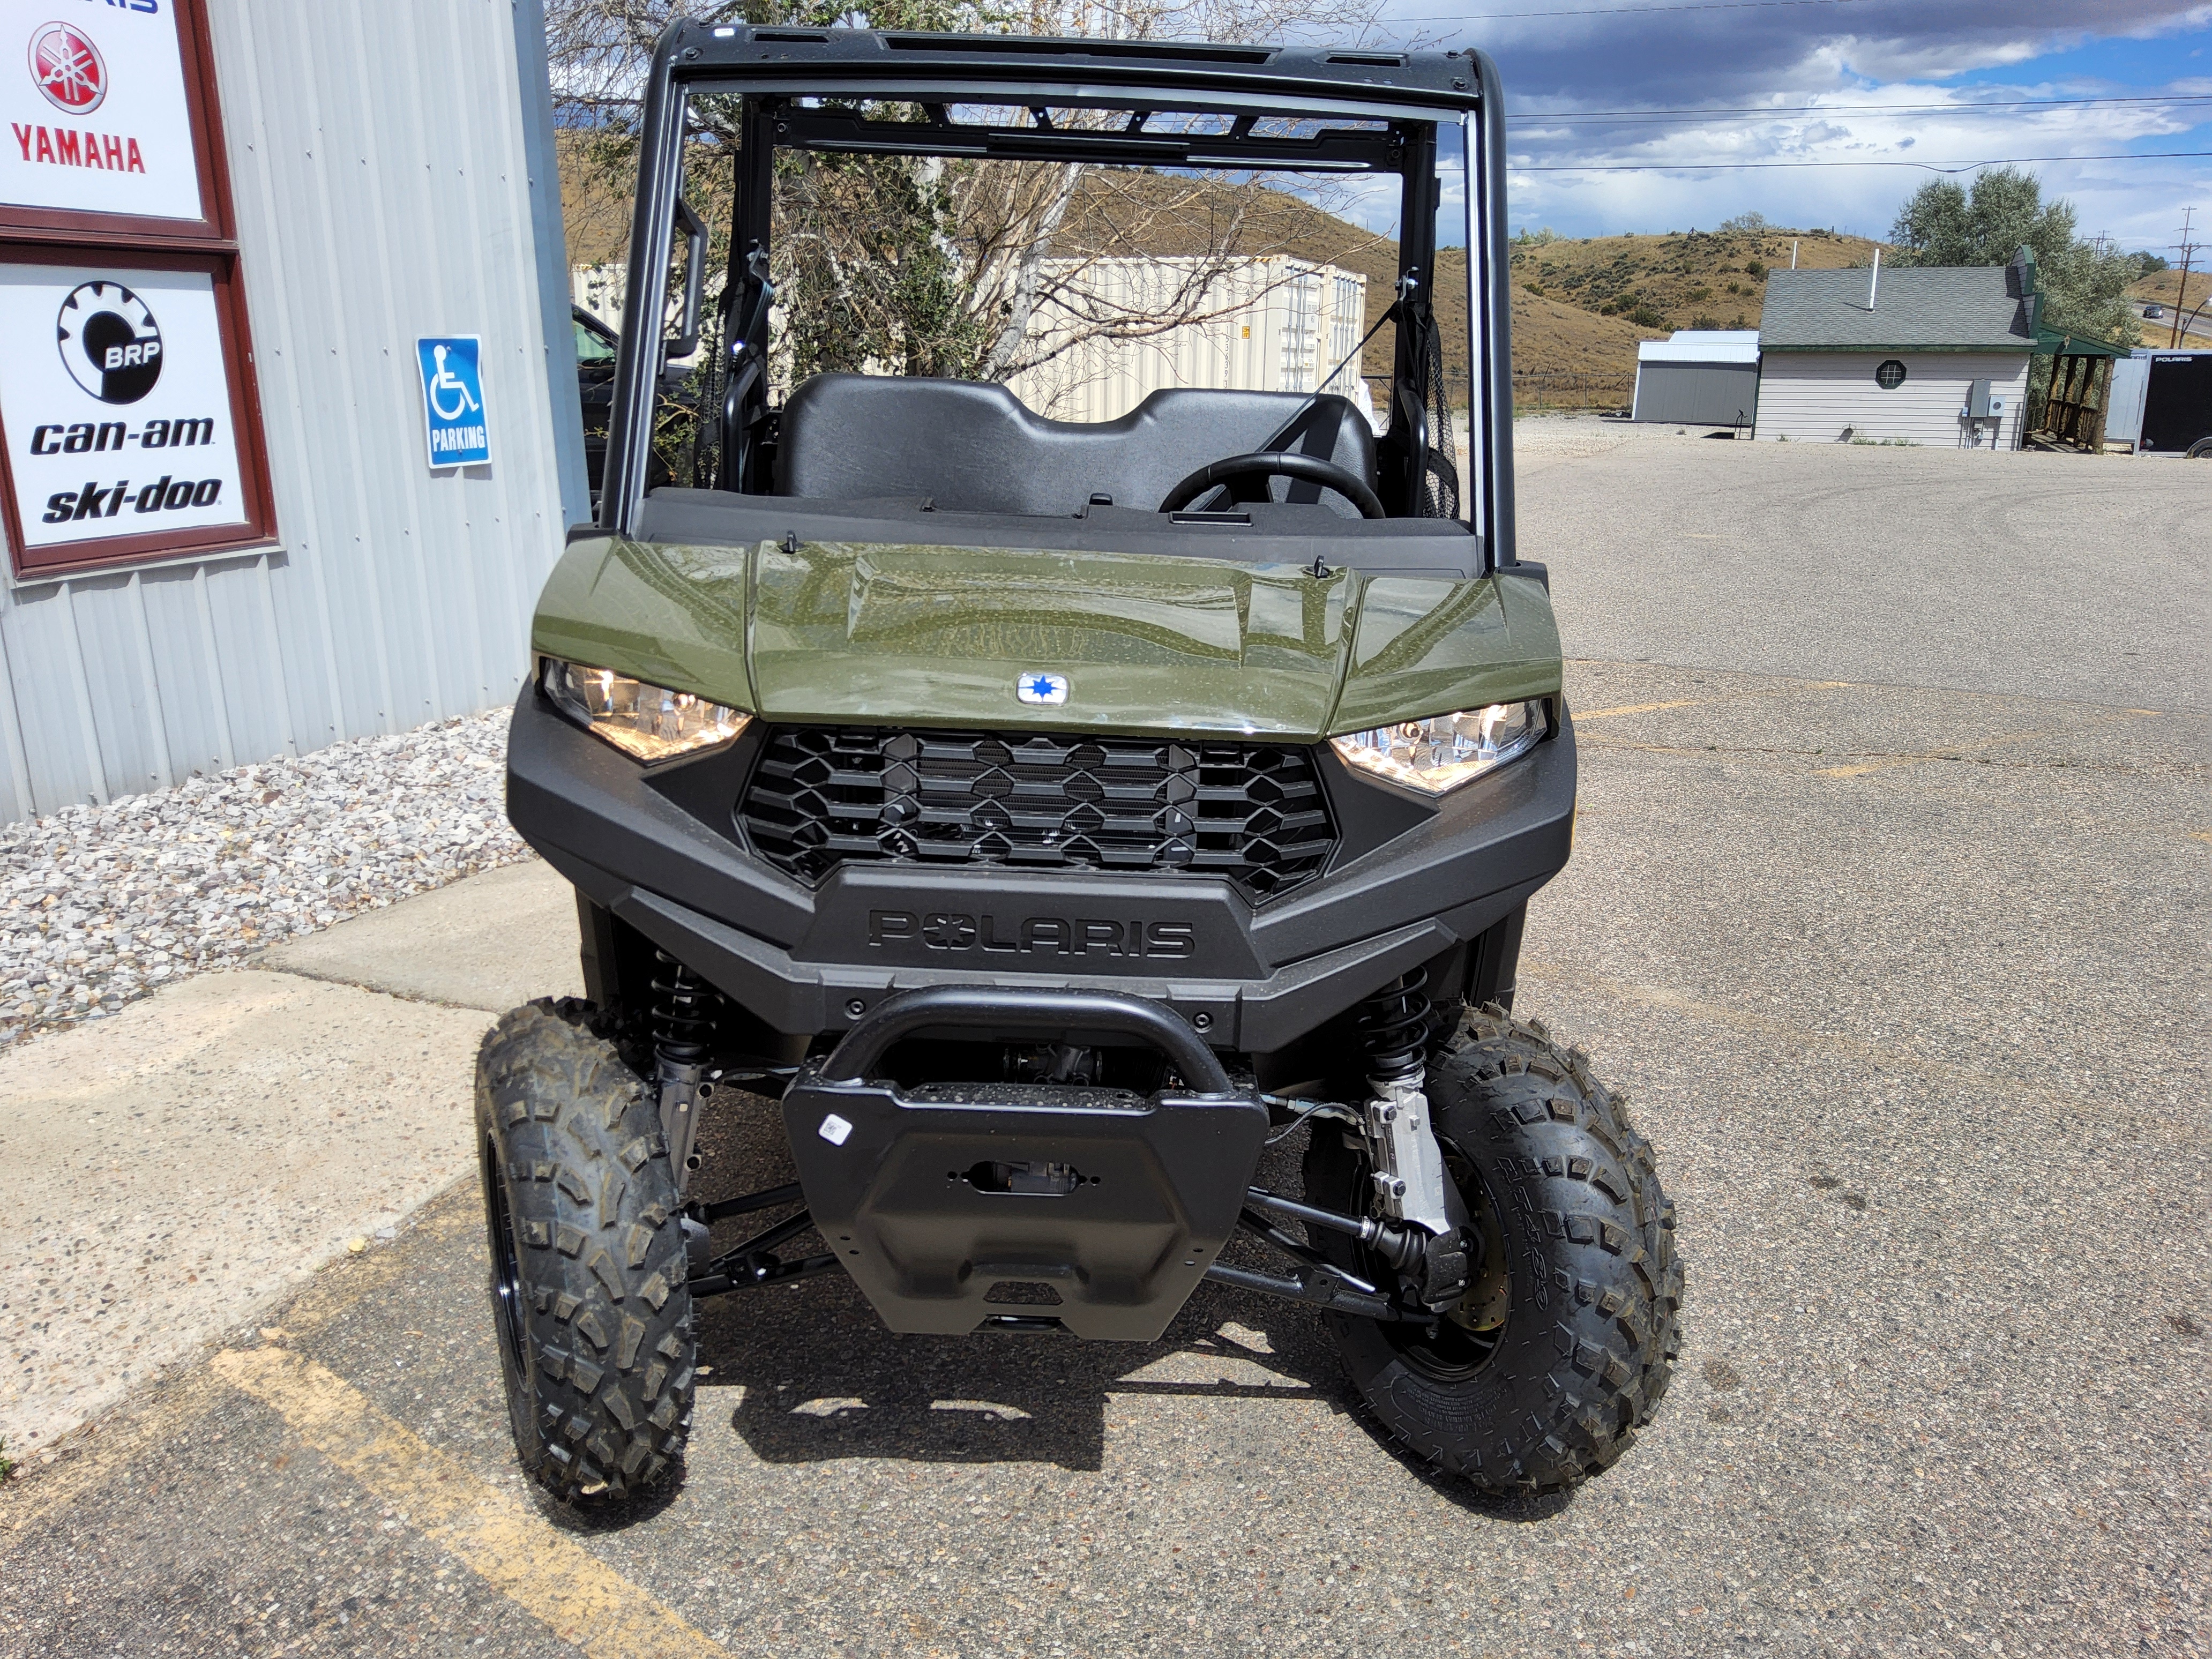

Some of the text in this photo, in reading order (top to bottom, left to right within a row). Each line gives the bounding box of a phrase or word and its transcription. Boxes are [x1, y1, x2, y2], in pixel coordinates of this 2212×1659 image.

[11, 122, 146, 174] YAMAHA
[105, 342, 160, 369] BRP
[30, 417, 214, 455] can-am
[432, 425, 485, 452] PARKING
[42, 475, 222, 523] ski-doo
[868, 909, 1195, 959] POLARIS
